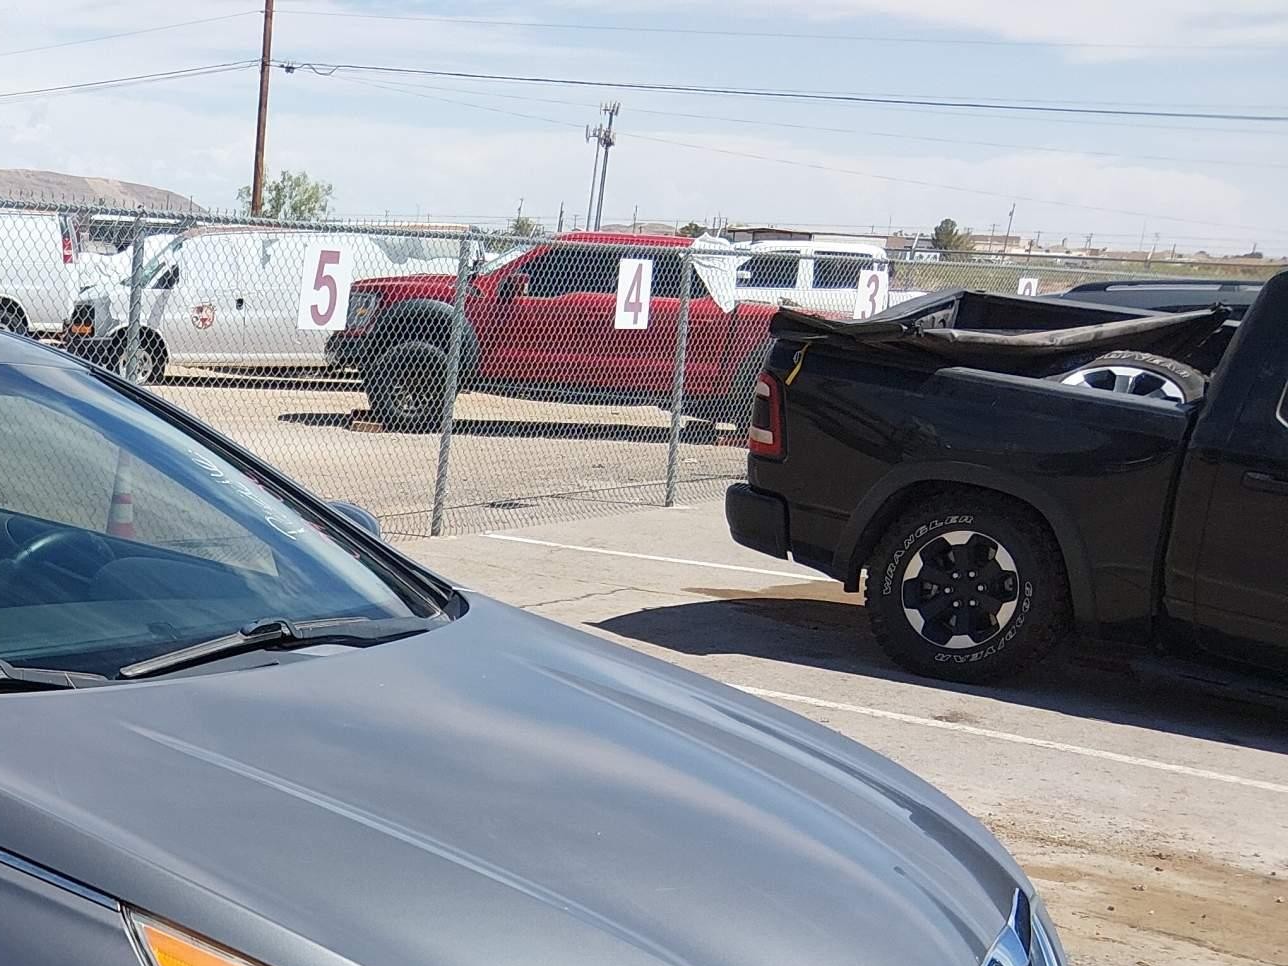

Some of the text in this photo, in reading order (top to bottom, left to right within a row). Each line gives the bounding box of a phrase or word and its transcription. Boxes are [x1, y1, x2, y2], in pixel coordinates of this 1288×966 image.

[310, 249, 340, 326] 5
[623, 263, 643, 325] 4
[861, 274, 879, 319] 3
[882, 515, 974, 595] WRANGLER
[934, 581, 1033, 662] GOODYEAR
